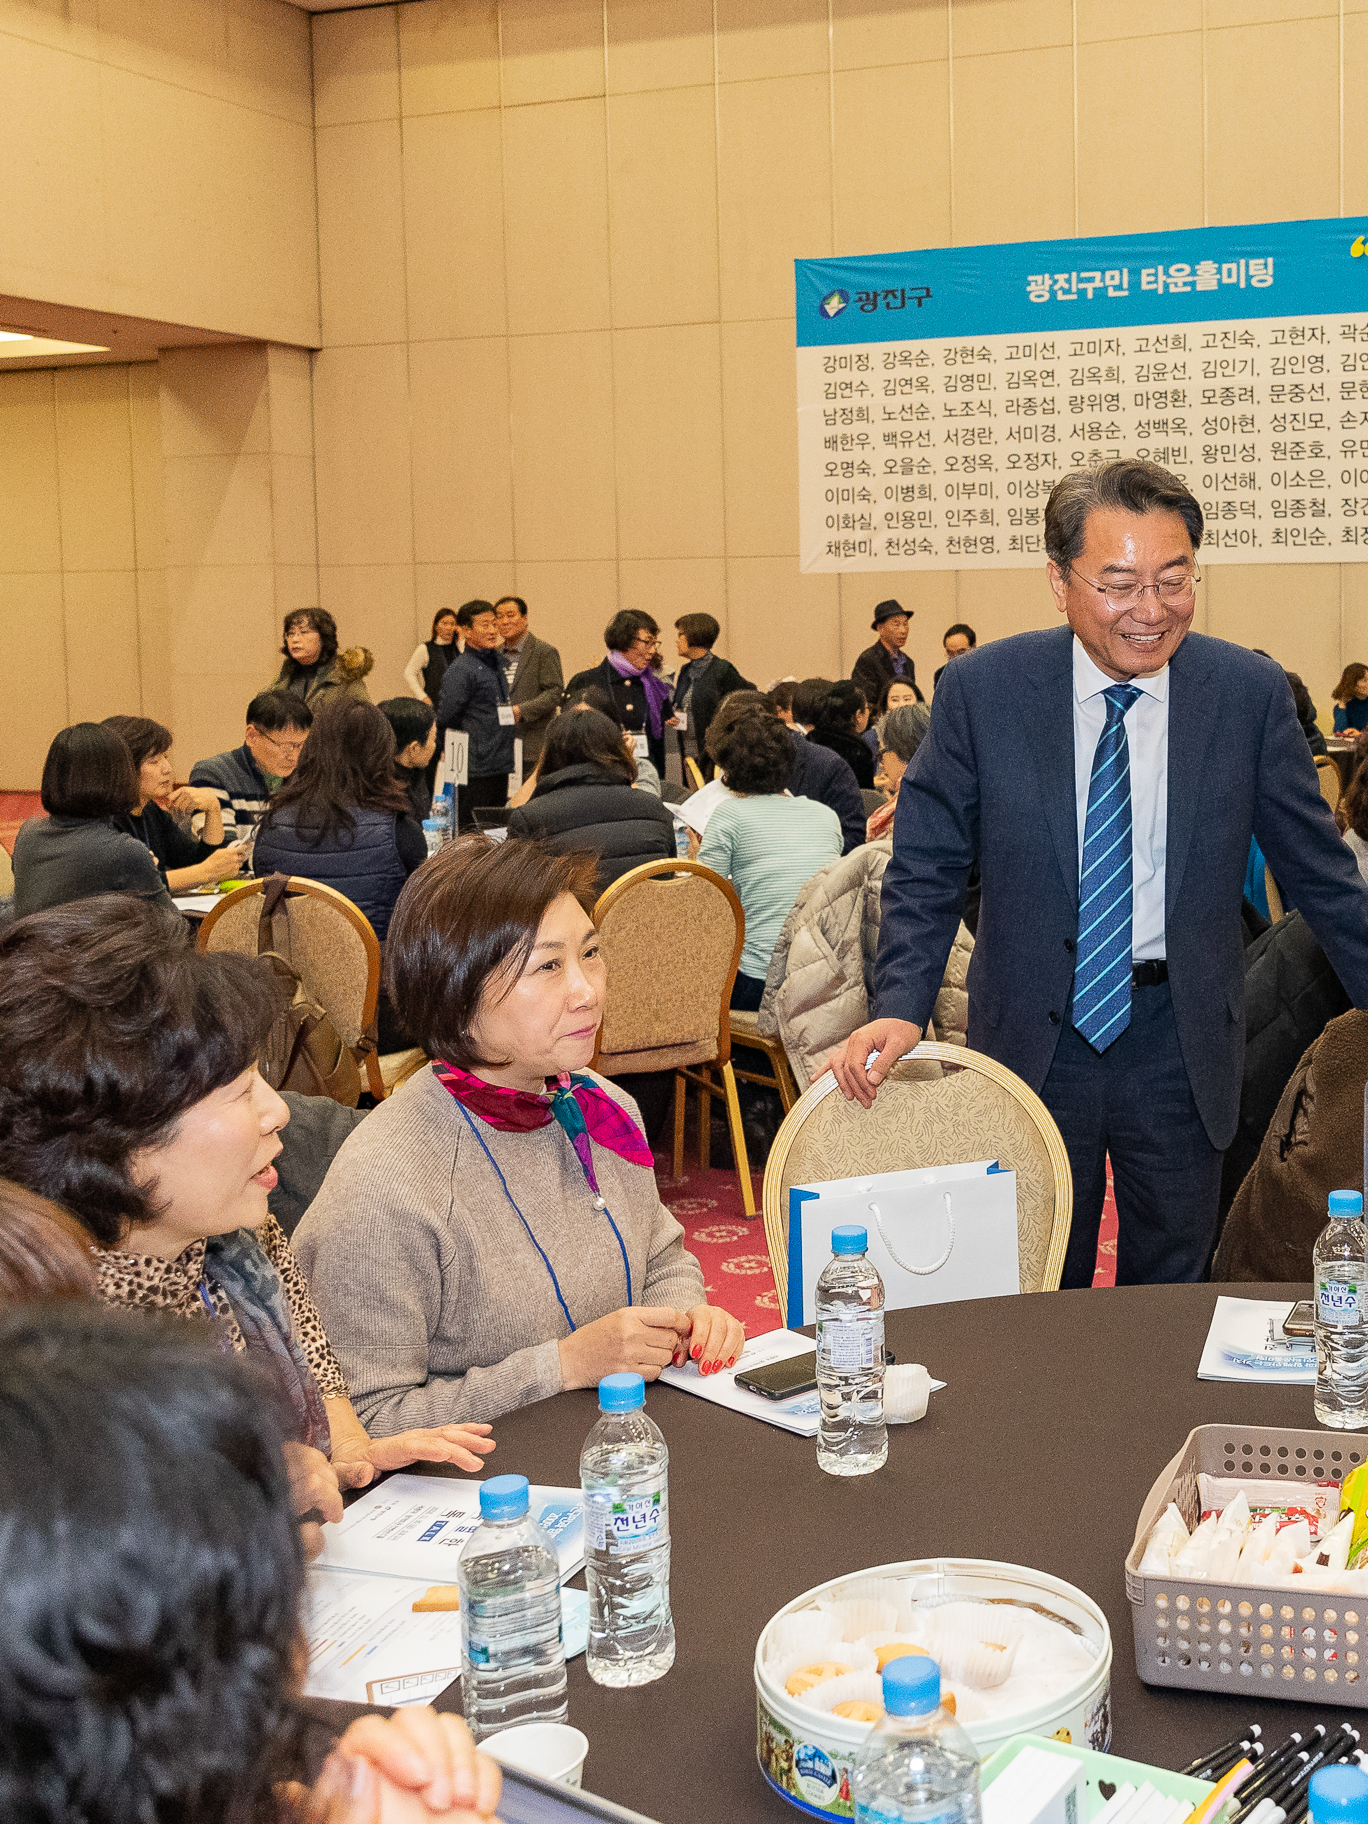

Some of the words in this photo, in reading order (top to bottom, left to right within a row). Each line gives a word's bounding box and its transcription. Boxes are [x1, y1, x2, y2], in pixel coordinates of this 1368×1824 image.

[1026, 266, 1130, 304] 광진구민
[1141, 257, 1275, 296] 타운홀미팅
[854, 286, 933, 314] 광진구
[823, 352, 874, 374] 강미정,
[882, 349, 934, 371] 강옥순,
[943, 345, 996, 367] 강현숙,
[1004, 341, 1060, 362] 고미선,
[1068, 337, 1125, 358] 고미자,
[1134, 333, 1192, 354] 고선희,
[1201, 329, 1260, 350] 고진숙,
[1269, 325, 1330, 346] 고현자,
[824, 380, 874, 400] 김연수,
[882, 375, 934, 397] 김연옥,
[944, 372, 996, 393] 김영민,
[1006, 368, 1060, 390] 김옥연,
[1070, 365, 1125, 387] 김옥희,
[1135, 360, 1191, 383] 김윤선,
[1202, 357, 1260, 380] 김인기,
[1270, 353, 1330, 376] 김인영,
[823, 405, 874, 427] 남정희,
[882, 402, 935, 422] 노선순,
[943, 399, 997, 418] 노조식,
[1006, 395, 1060, 417] 라종섭,
[1134, 388, 1192, 410] 마영환,
[1200, 385, 1260, 407] 모종려,
[1269, 382, 1330, 404] 문중선,
[824, 432, 875, 452] 배한우,
[883, 429, 935, 449] 백유선,
[943, 426, 997, 447] 서경란,
[1006, 423, 1061, 444] 서미경,
[1070, 420, 1126, 442] 서용순,
[1134, 417, 1192, 439] 성백옥,
[1201, 413, 1260, 436] 성아현,
[1270, 411, 1330, 433] 성진모,
[824, 459, 876, 479] 오명숙,
[883, 456, 936, 476] 오을순,
[944, 453, 998, 474] 오정옥,
[1006, 451, 1061, 472] 오정자,
[1201, 442, 1261, 465] 왕민성,
[1270, 440, 1330, 462] 원준호,
[825, 485, 876, 506] 이미숙,
[884, 483, 937, 503] 이병희,
[945, 481, 998, 501] 이부미,
[1202, 471, 1261, 492] 이선해,
[1271, 468, 1331, 491] 이소은,
[826, 511, 877, 532] 이화실,
[884, 510, 937, 530] 인용민,
[945, 508, 999, 528] 인주희,
[1202, 499, 1261, 524] 임종덕,
[1271, 497, 1331, 519] 임종철,
[826, 538, 877, 558] 채현미,
[885, 537, 938, 557] 천성숙,
[946, 535, 1000, 555] 천현영,
[1202, 528, 1262, 552] 최선아,
[1271, 526, 1331, 548] 최인순,
[450, 741, 464, 774] 10
[1320, 1292, 1357, 1309] 천년수
[613, 1508, 661, 1532] 천년수
